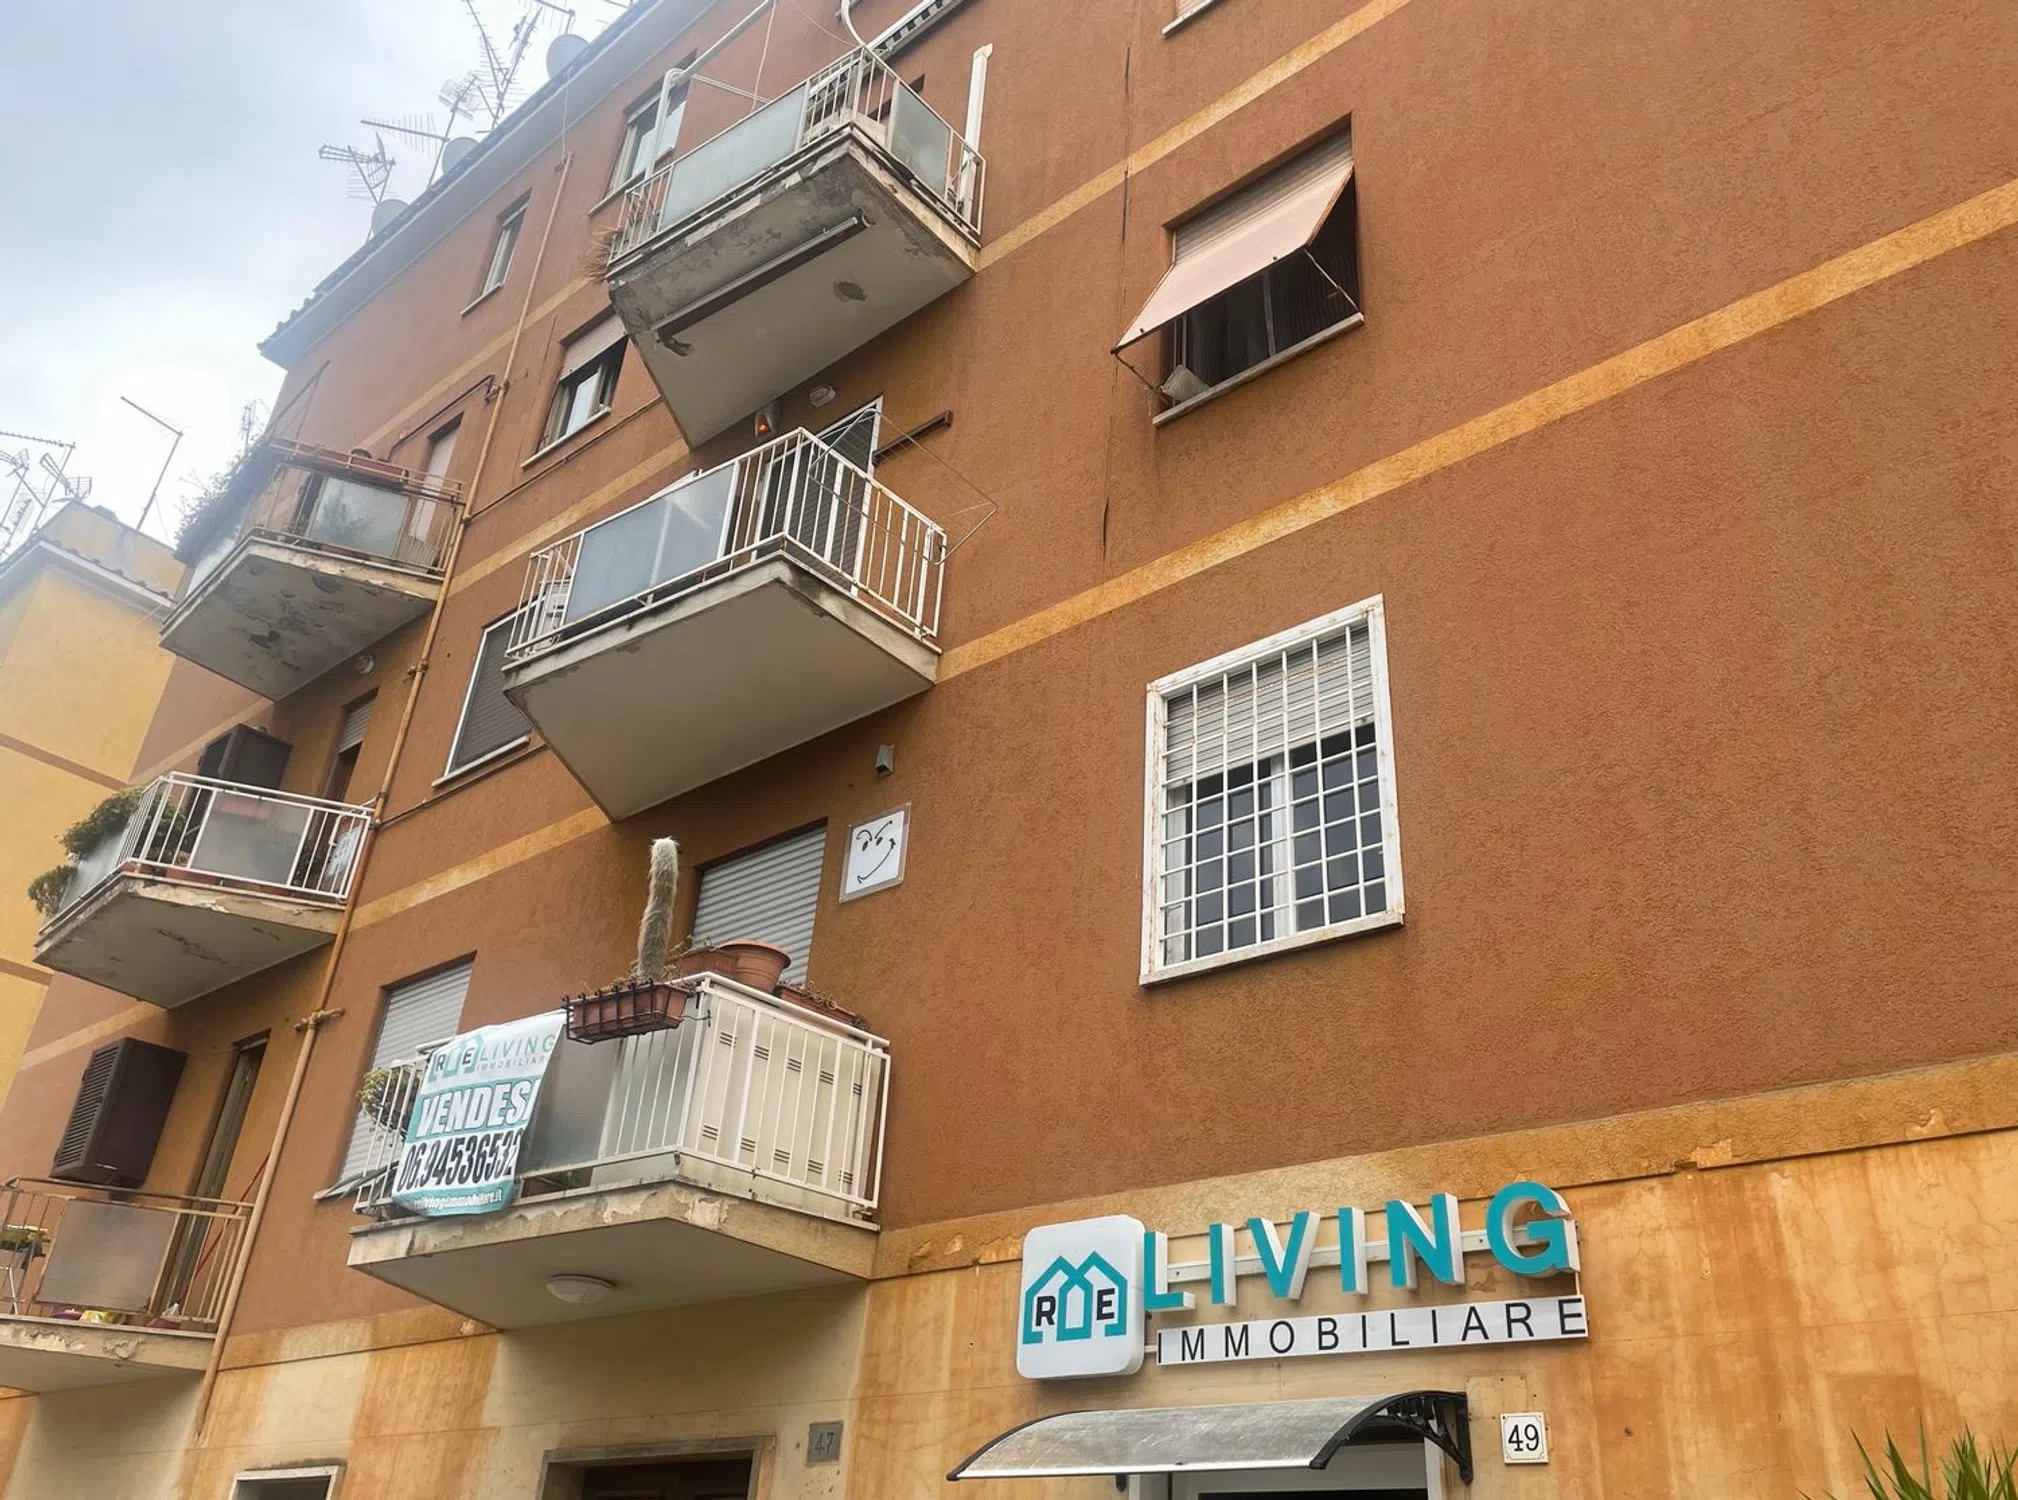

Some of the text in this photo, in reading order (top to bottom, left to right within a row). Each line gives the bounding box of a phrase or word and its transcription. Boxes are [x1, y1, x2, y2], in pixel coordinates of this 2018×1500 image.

[480, 1034, 556, 1062] LIVING
[476, 1054, 548, 1071] IMMOBILIAR
[1144, 1181, 1579, 1310] LIVING
[1158, 1298, 1586, 1363] IMMOBILIARE
[815, 1432, 835, 1456] 47
[1508, 1424, 1539, 1451] 49
